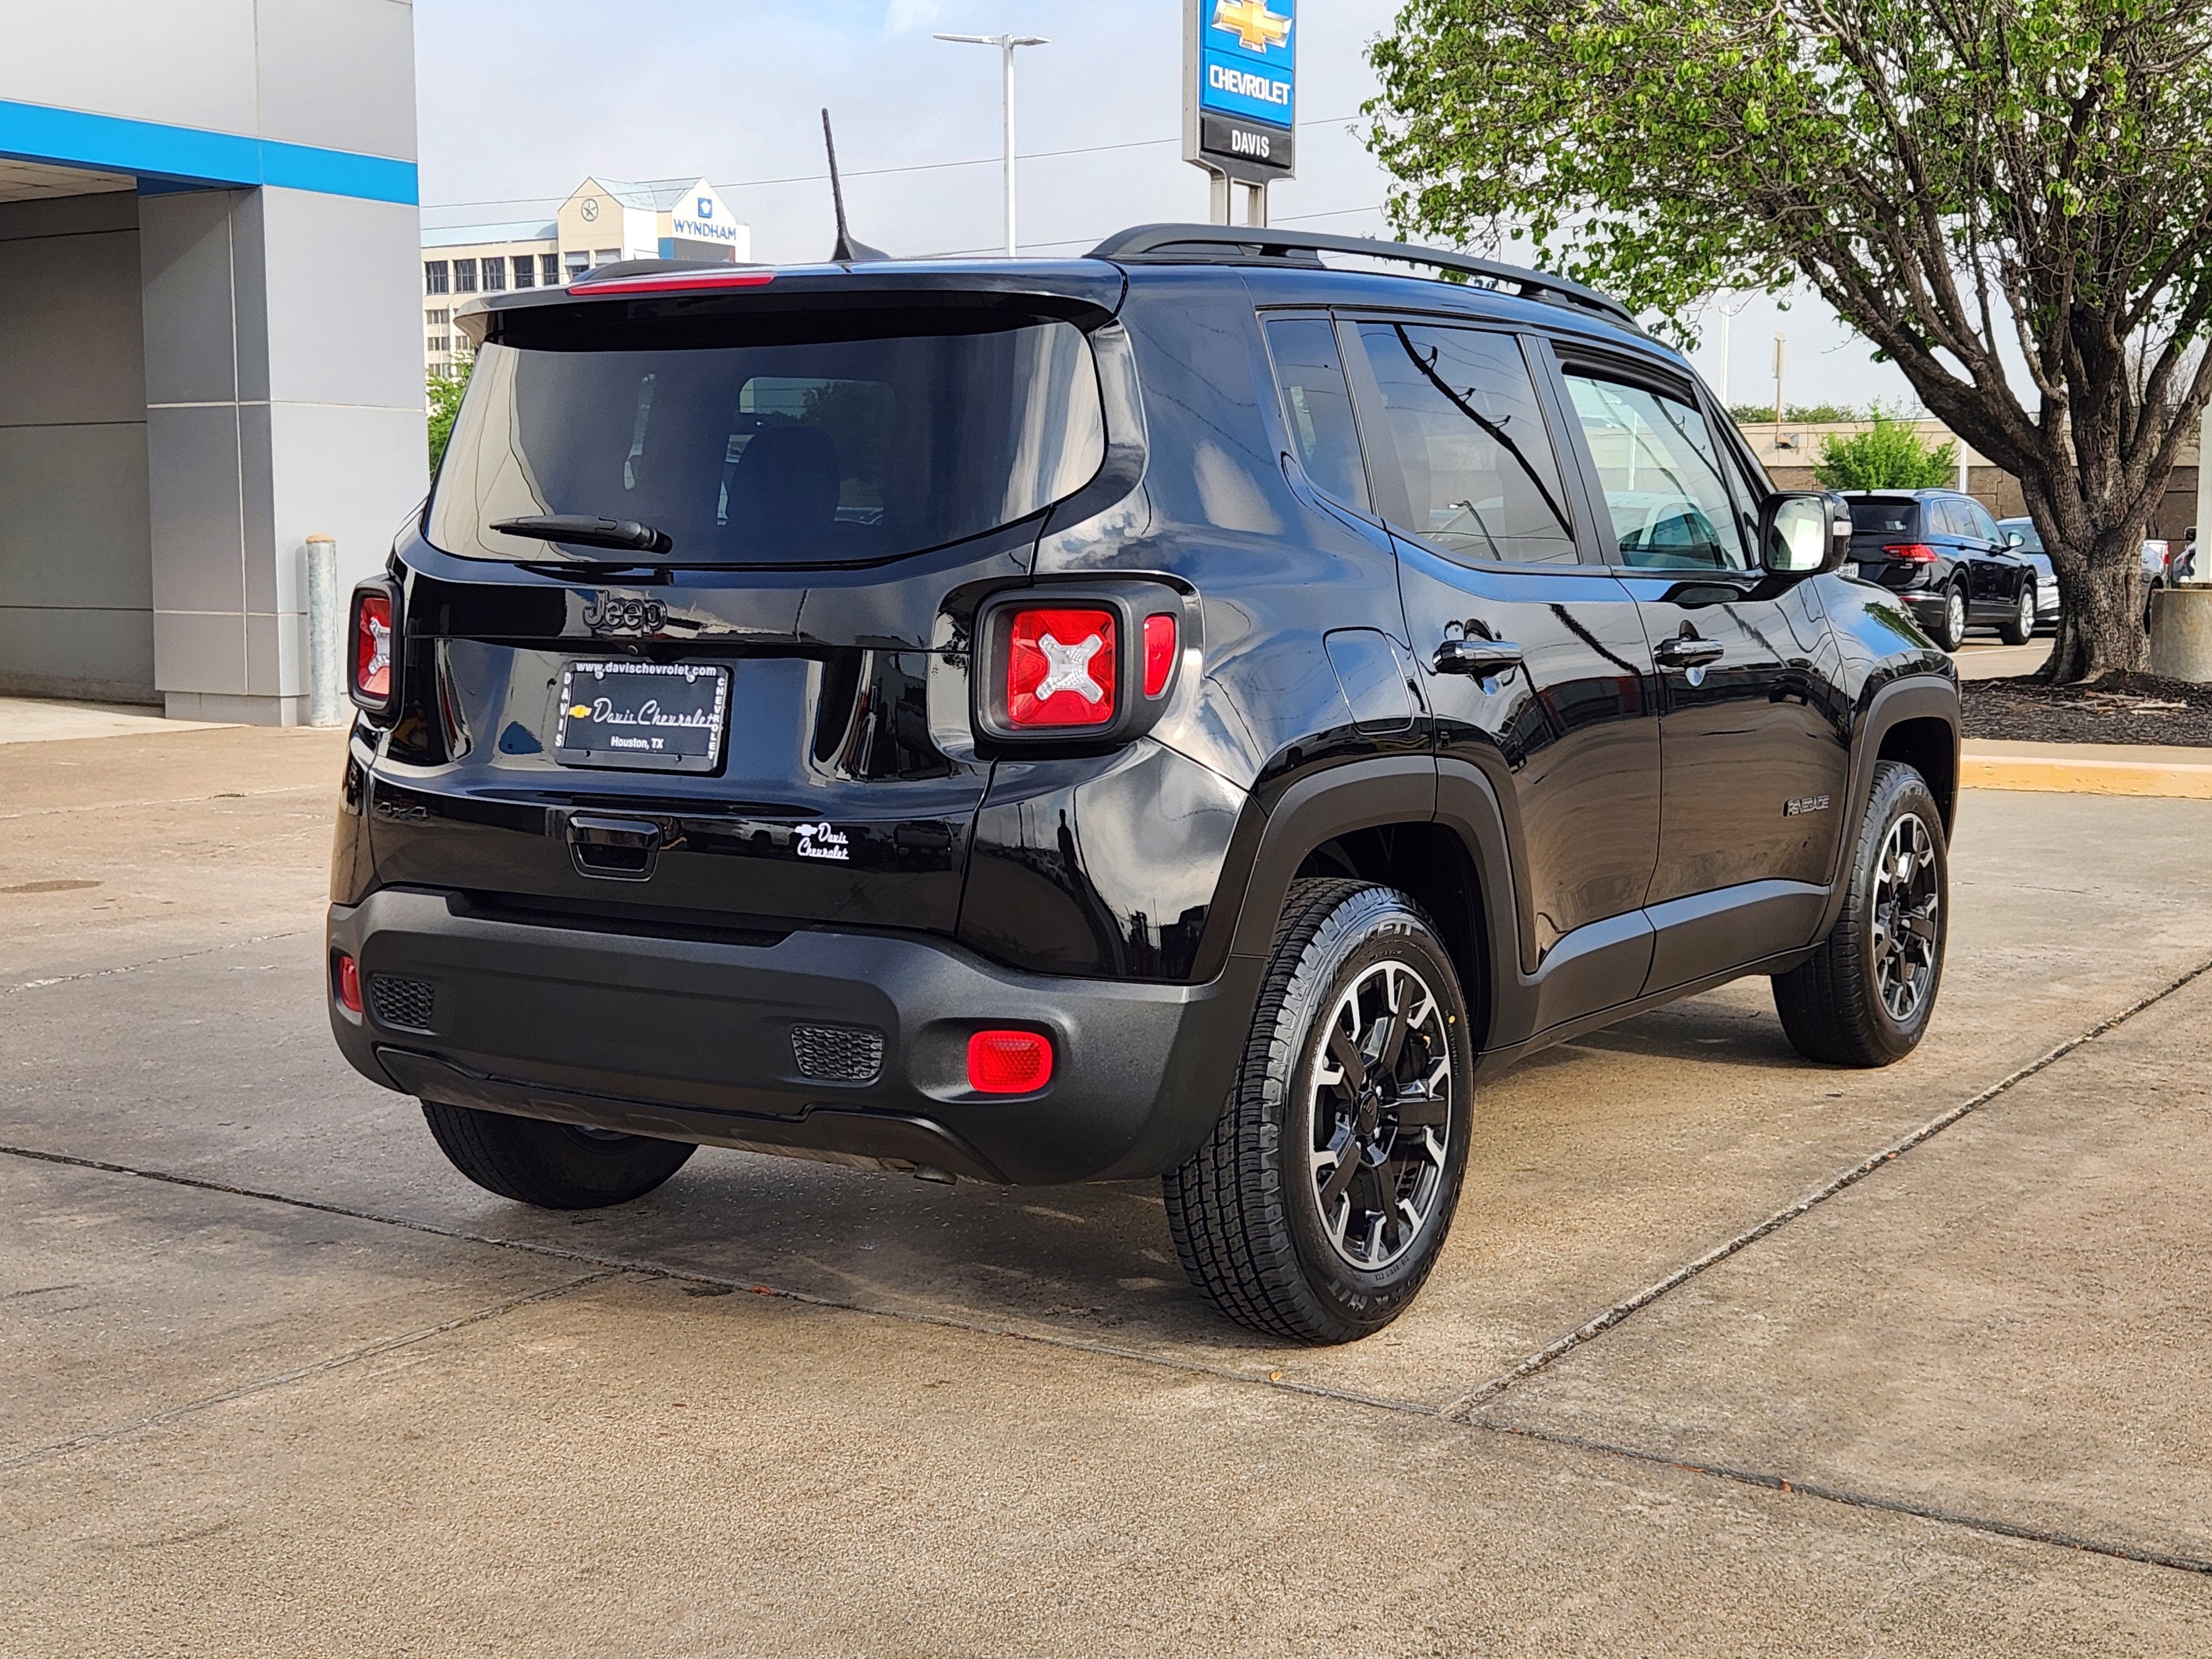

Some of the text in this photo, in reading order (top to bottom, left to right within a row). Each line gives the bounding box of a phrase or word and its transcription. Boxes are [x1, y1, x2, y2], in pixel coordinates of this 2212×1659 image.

[1209, 64, 1290, 105] CHEVROLET
[1232, 129, 1270, 158] DAVIS
[674, 218, 737, 241] WYNDHAM
[583, 590, 668, 636] Jeep
[576, 662, 717, 677] www.davischevrolet.com
[555, 671, 572, 748] DAVIS
[593, 697, 713, 727] Davis Chevrolet
[708, 677, 726, 760] CHEVROLET
[611, 735, 664, 750] Houston, TX
[818, 822, 849, 844] Davis
[797, 837, 850, 860] Chevrolet
